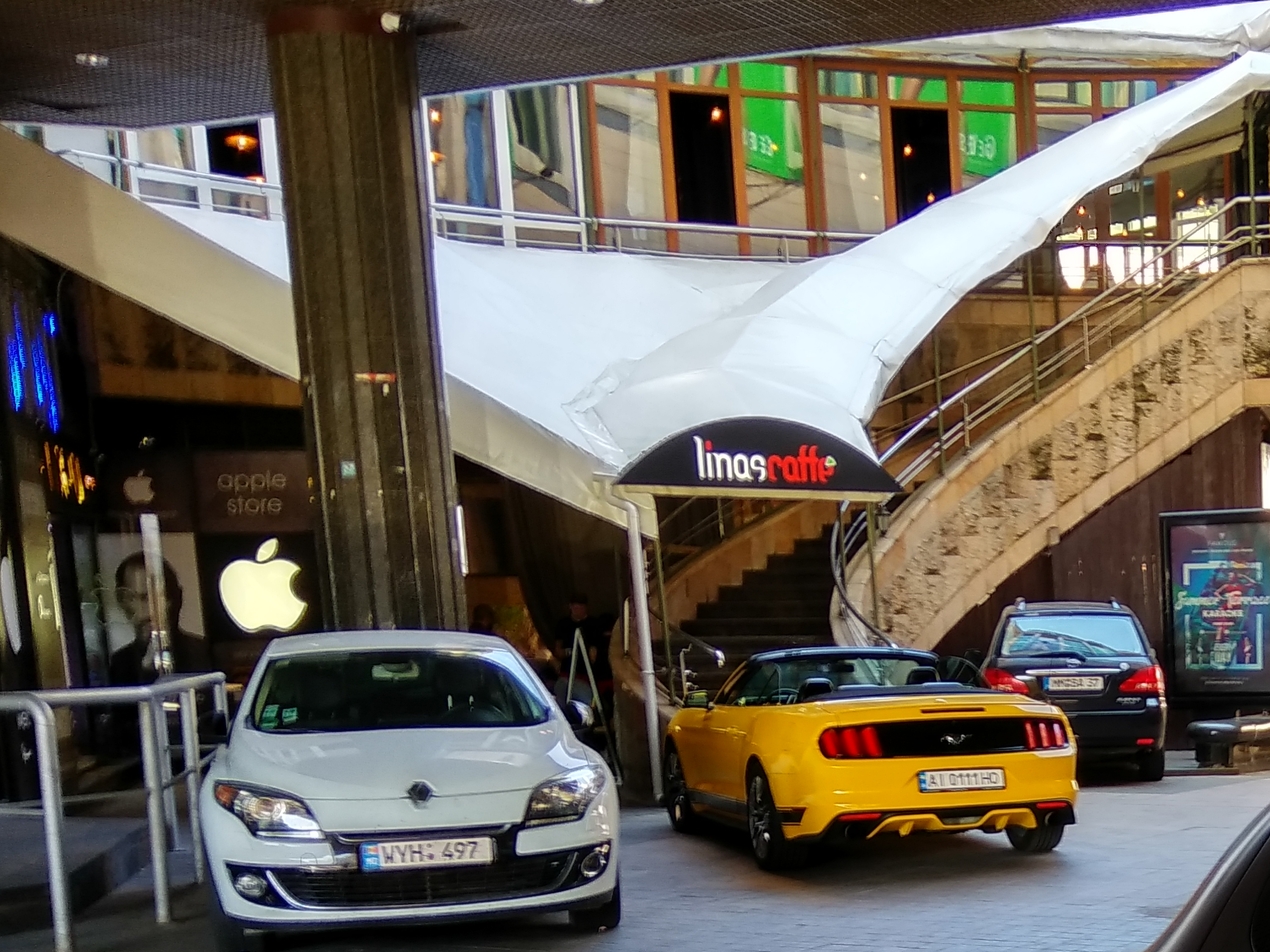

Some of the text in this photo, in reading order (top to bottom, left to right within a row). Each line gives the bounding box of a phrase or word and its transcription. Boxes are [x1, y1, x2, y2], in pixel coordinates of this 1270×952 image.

[217, 469, 287, 493] apple
[226, 495, 283, 516] store
[381, 843, 424, 864] WYH
[442, 841, 478, 861] 497
